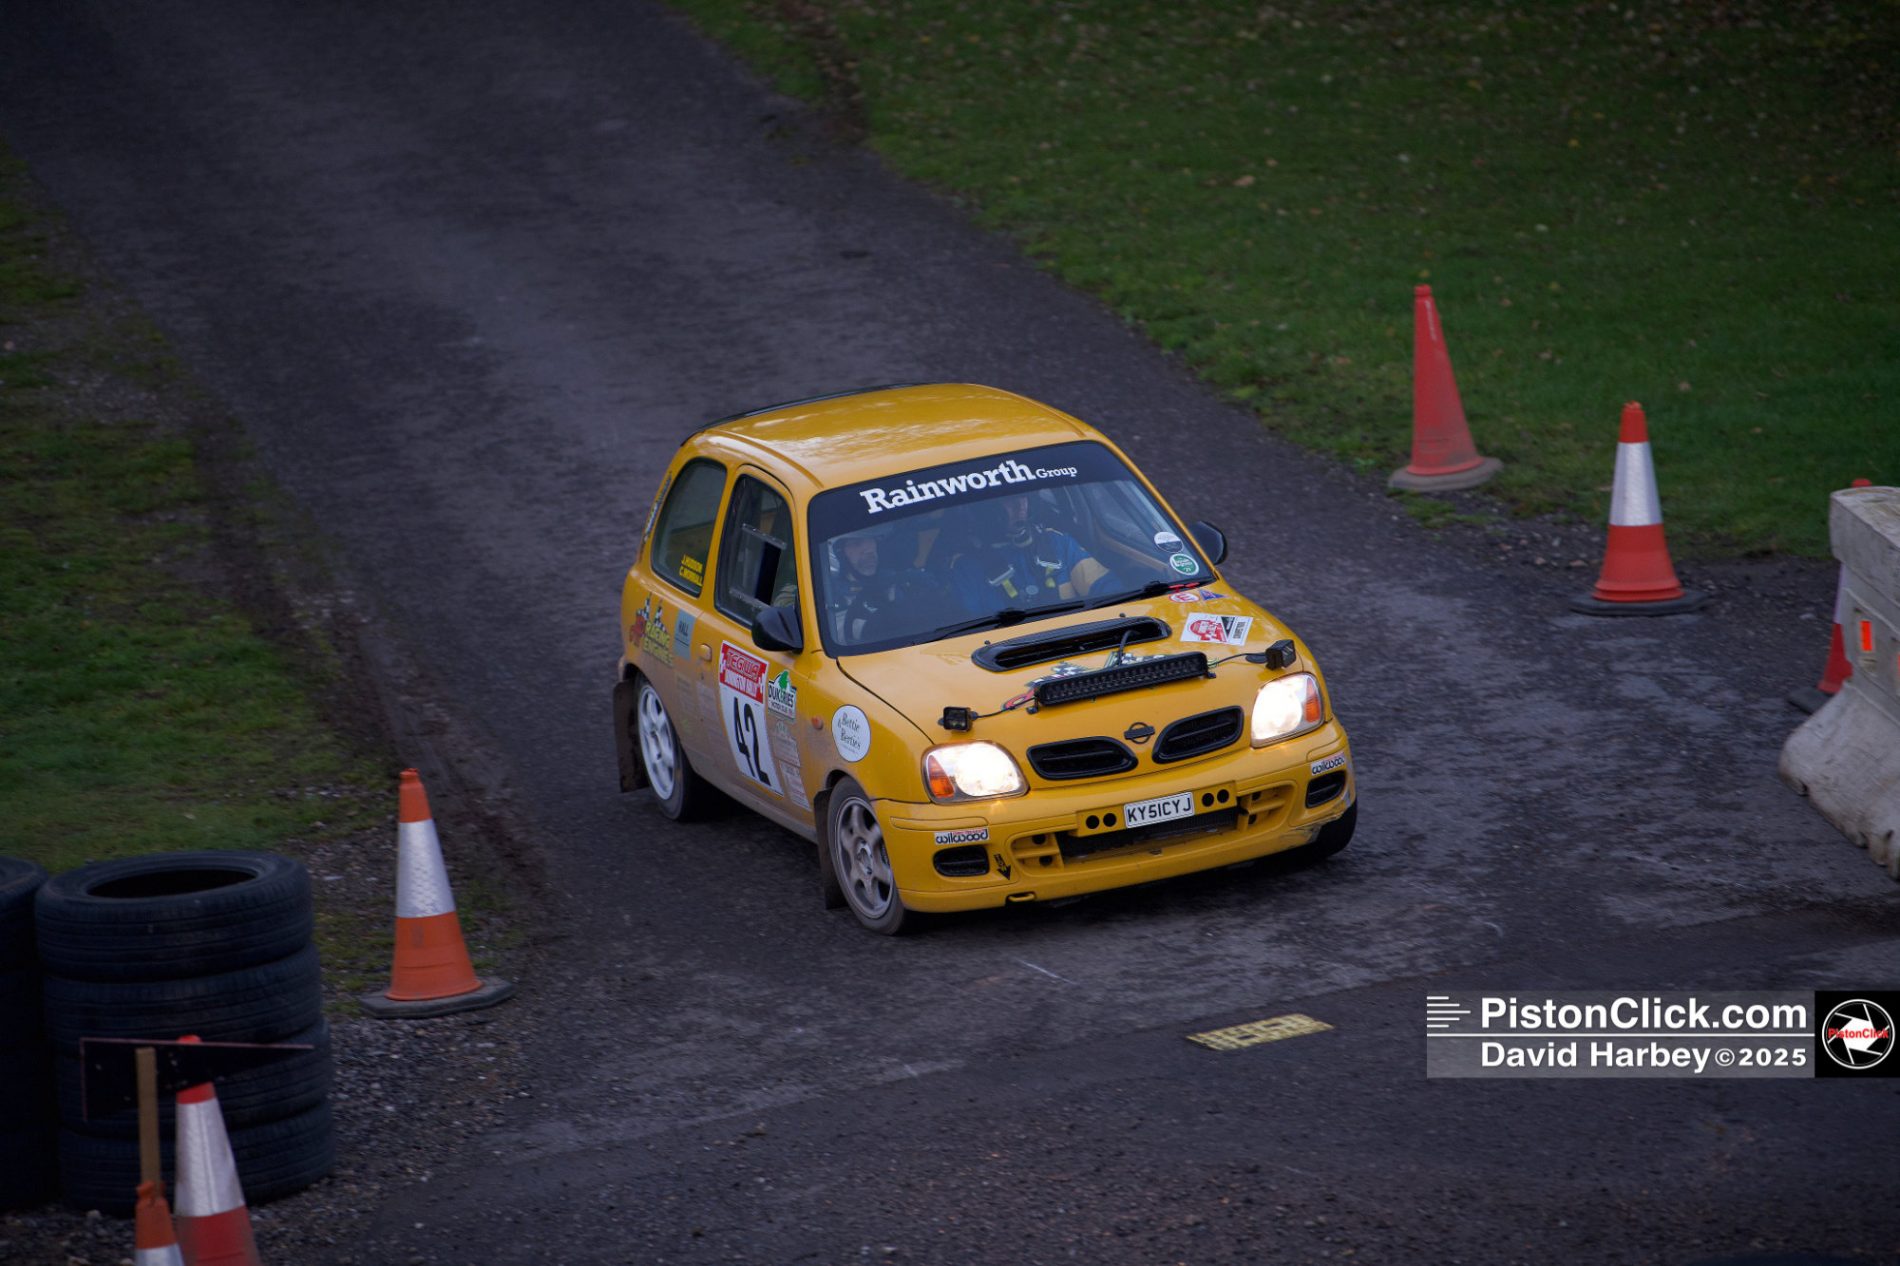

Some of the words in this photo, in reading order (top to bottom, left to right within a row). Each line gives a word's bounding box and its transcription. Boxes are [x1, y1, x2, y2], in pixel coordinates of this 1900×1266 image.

[860, 460, 1037, 514] Rainworth
[1035, 465, 1078, 480] Group
[725, 650, 760, 676] TEGIWA
[734, 696, 772, 787] 42
[935, 828, 989, 844] wilwood
